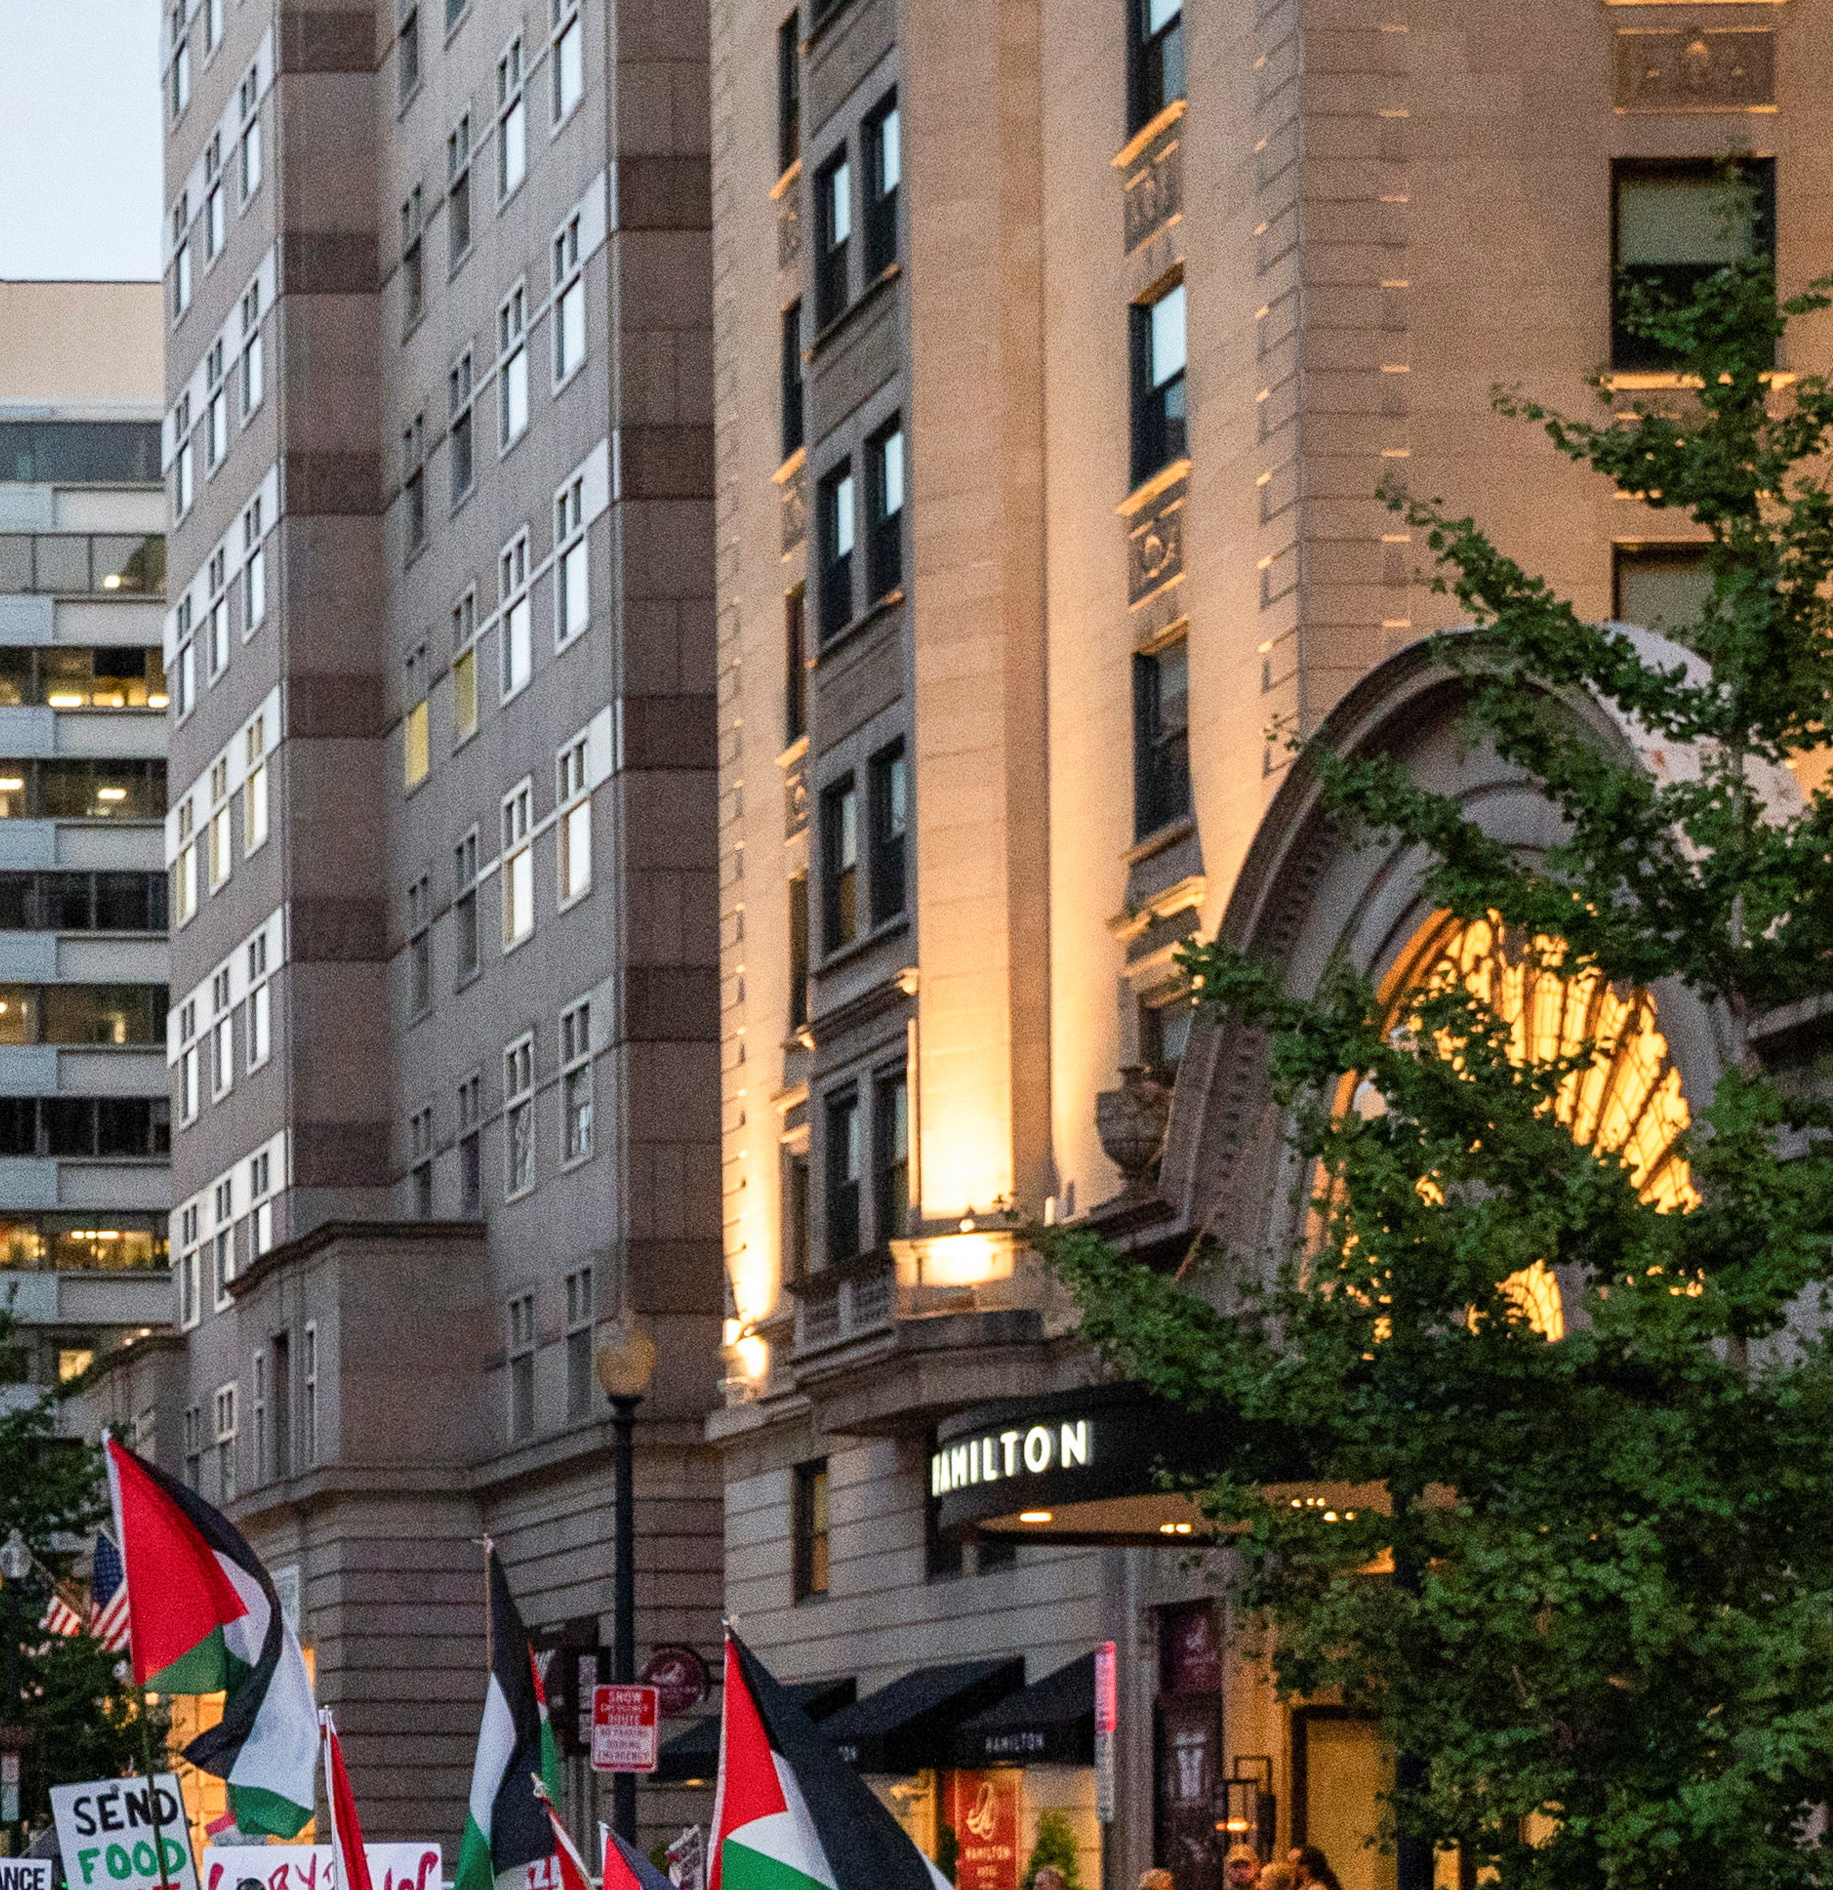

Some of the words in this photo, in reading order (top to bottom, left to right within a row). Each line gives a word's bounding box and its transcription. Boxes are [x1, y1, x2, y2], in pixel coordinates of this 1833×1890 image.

[932, 1420, 1088, 1497] HAMILTON
[73, 1788, 178, 1836] SEND
[78, 1837, 187, 1885] FOOD
